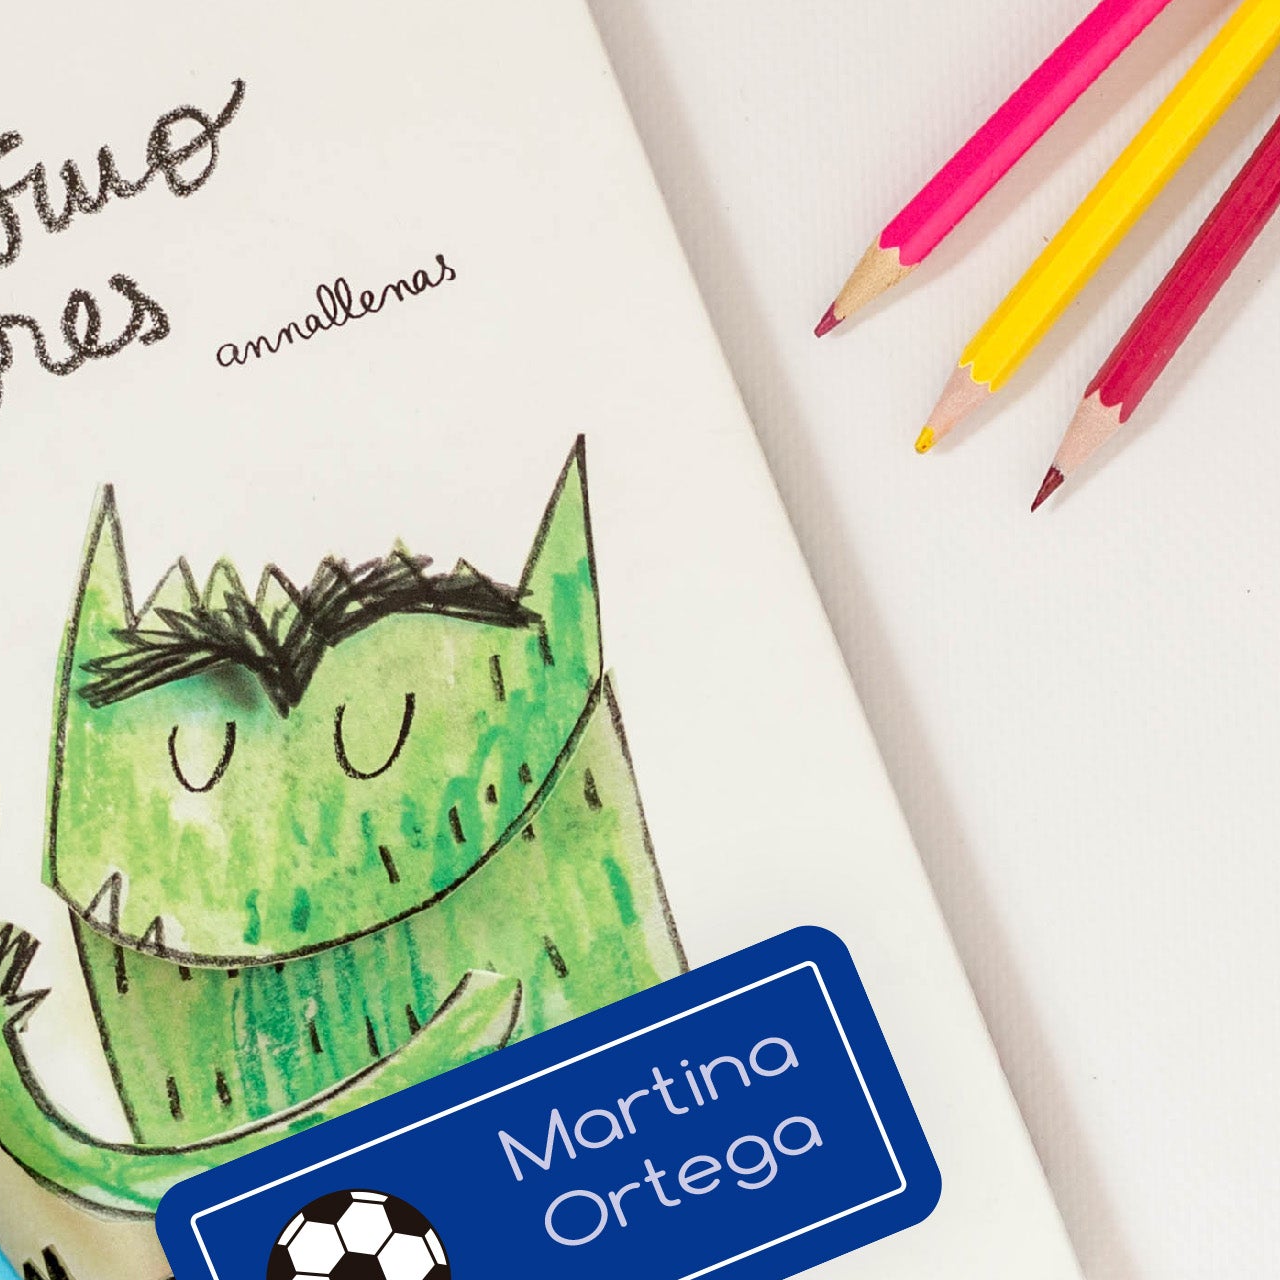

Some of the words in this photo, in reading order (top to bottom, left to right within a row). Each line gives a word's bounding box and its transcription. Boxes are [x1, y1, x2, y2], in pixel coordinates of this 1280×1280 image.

[217, 255, 456, 366] annallenas
[498, 1037, 799, 1181] Martina
[545, 1116, 823, 1246] Ortega
